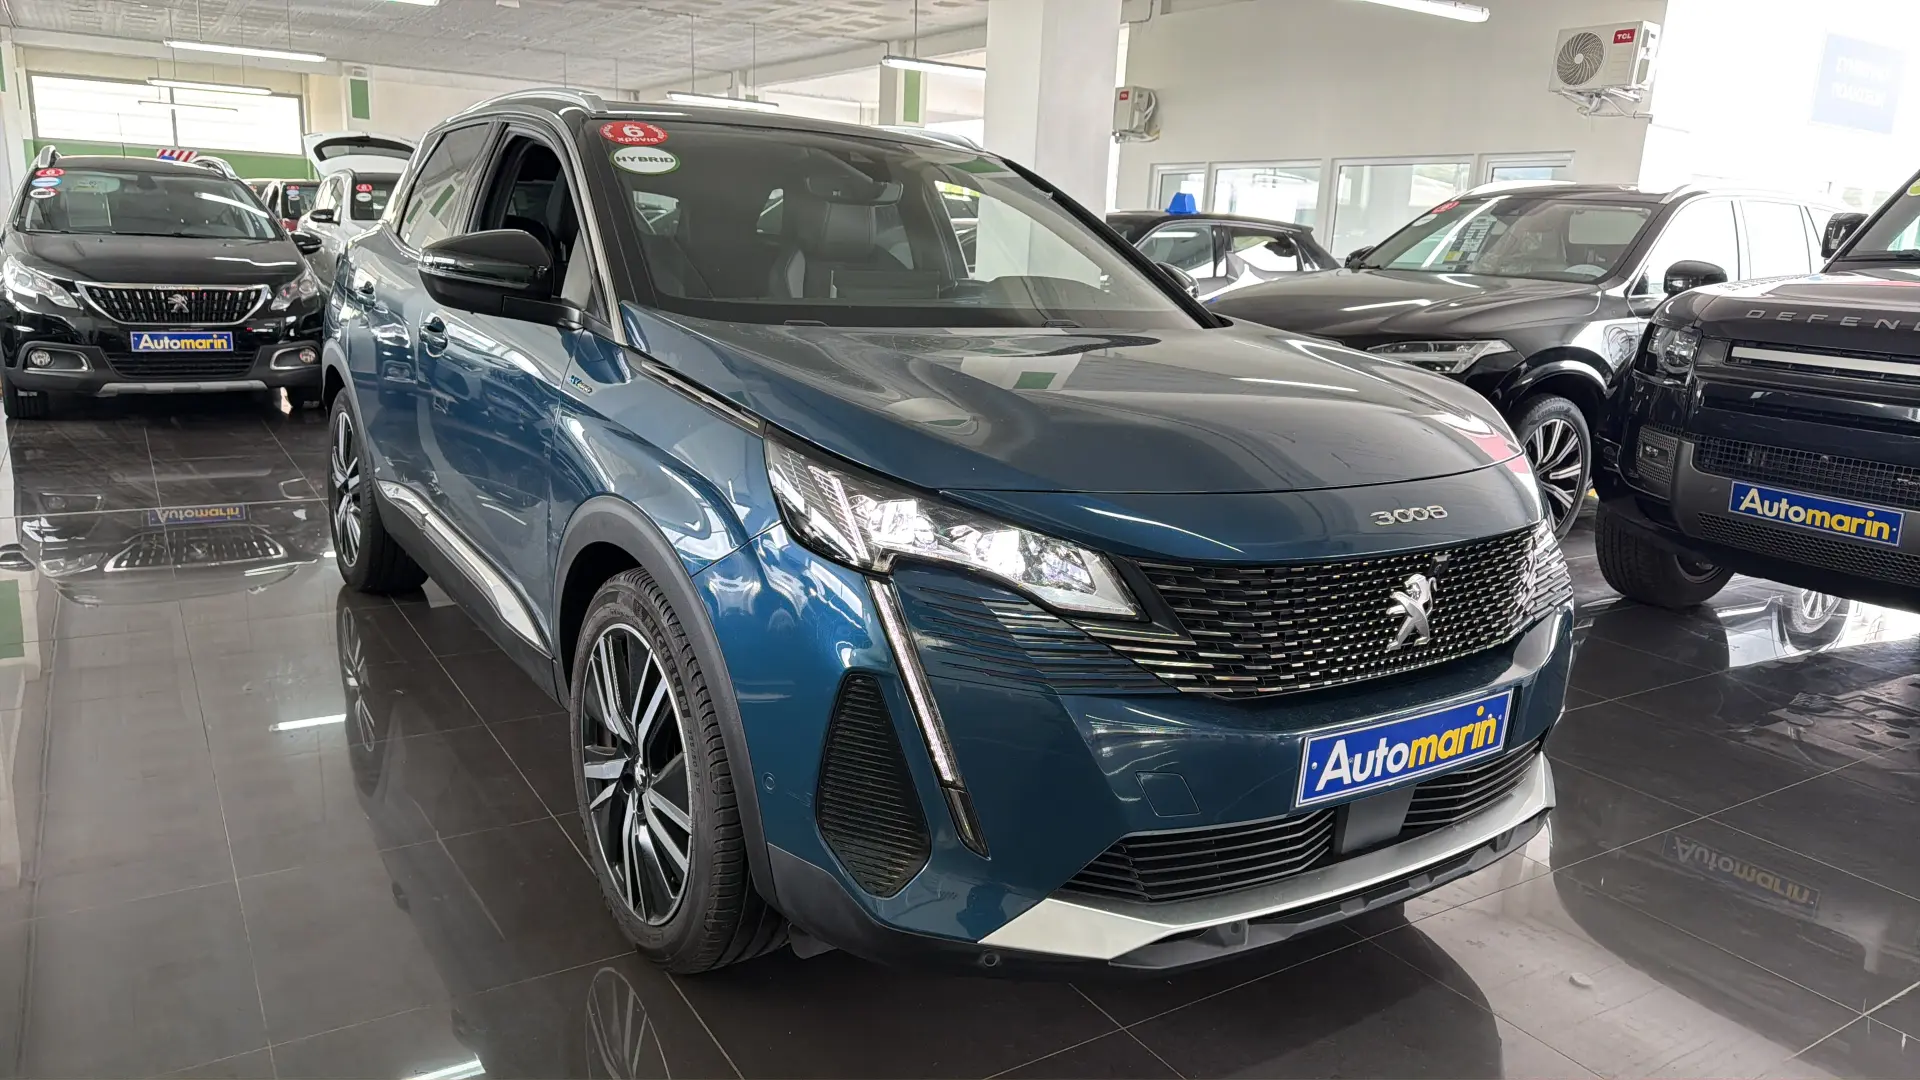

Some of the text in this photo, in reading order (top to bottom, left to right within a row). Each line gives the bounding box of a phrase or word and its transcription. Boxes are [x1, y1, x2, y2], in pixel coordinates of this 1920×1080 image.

[623, 125, 644, 138] 6
[615, 152, 674, 163] HYBRID
[139, 333, 227, 350] Automarin
[1370, 505, 1448, 525] 3008
[1739, 487, 1890, 540] Automarin
[643, 617, 689, 715] MICHELIN
[1315, 705, 1497, 791] Automarin
